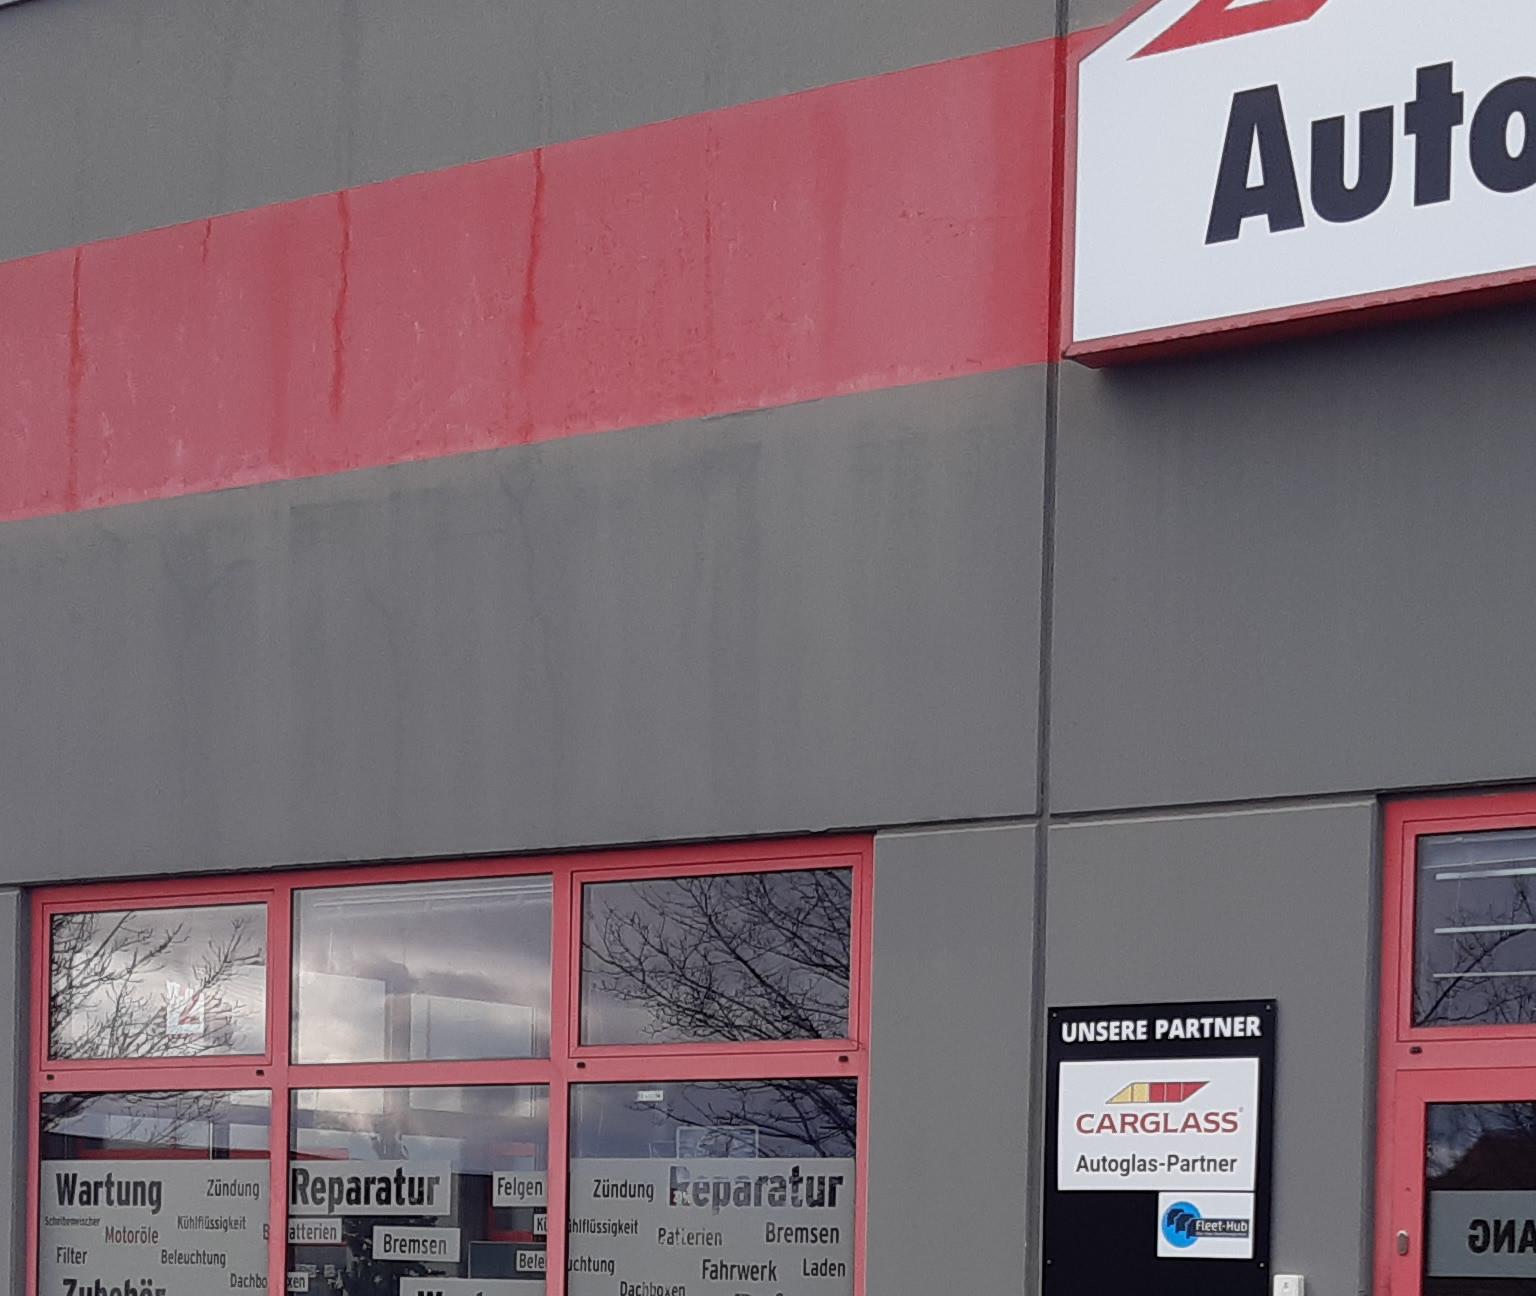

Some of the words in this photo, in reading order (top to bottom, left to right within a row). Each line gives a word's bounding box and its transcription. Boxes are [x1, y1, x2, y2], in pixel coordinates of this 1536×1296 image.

[1062, 1020, 1148, 1043] UNSERE
[1156, 1016, 1262, 1039] PARTNER
[1076, 1111, 1239, 1134] CARGLASS
[1075, 1154, 1238, 1176] Autoglas-Partner
[56, 1173, 162, 1215] Wartung
[207, 1179, 260, 1200] Zündung
[291, 1167, 441, 1214] Reparatur
[497, 1177, 543, 1199] Felgen
[593, 1179, 654, 1202] Zündung
[669, 1165, 844, 1215] Reparatur
[105, 1225, 159, 1244] Motoröle
[177, 1215, 247, 1232] Kühlflüssigkeit
[766, 1221, 840, 1244] Bremsen
[1196, 1220, 1248, 1232] Fleet-Hub
[383, 1233, 447, 1255] Bremsen
[56, 1247, 87, 1264] Filter
[161, 1250, 226, 1268] Beleuchtung
[702, 1259, 776, 1282] Fahrwerk
[803, 1258, 846, 1277] Laden
